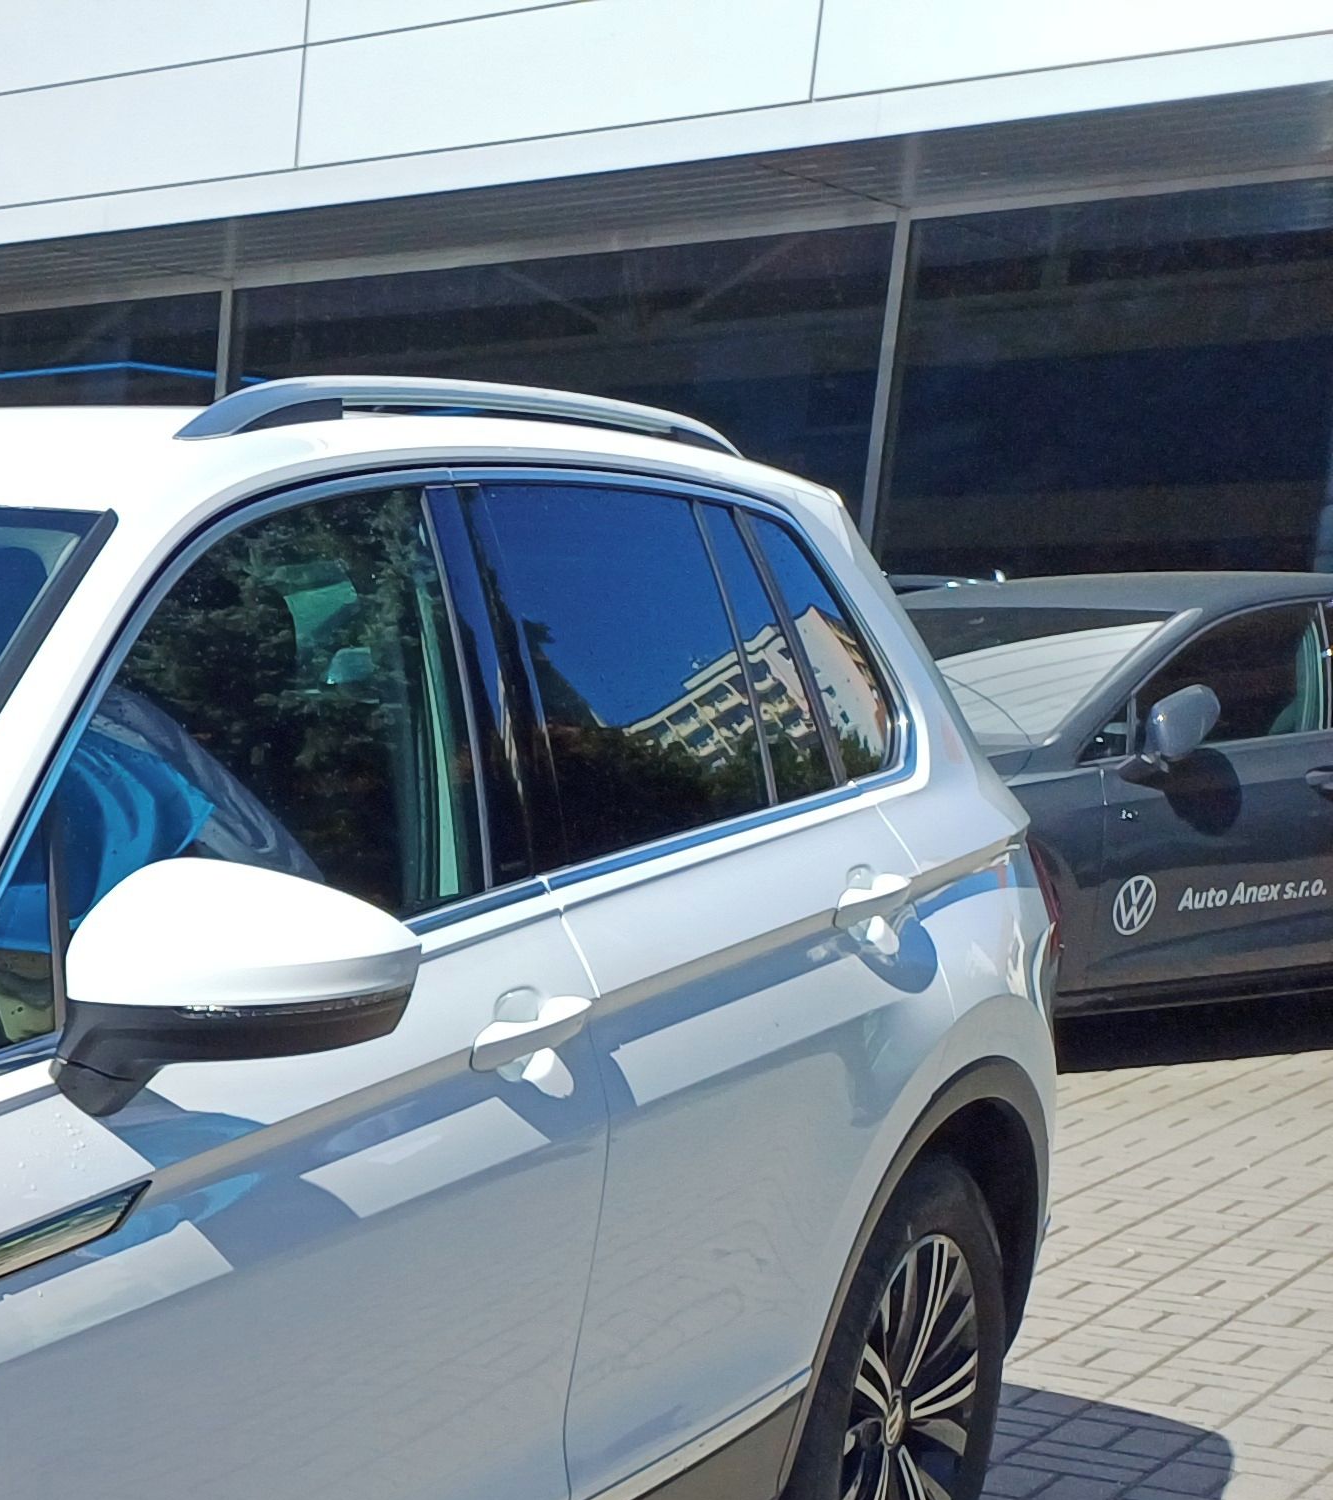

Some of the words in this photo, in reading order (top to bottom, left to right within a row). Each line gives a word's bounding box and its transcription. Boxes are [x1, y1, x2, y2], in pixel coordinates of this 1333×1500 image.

[1177, 887, 1228, 912] Auto
[1229, 881, 1281, 907] Anex
[1282, 878, 1328, 900] s.r.o.
